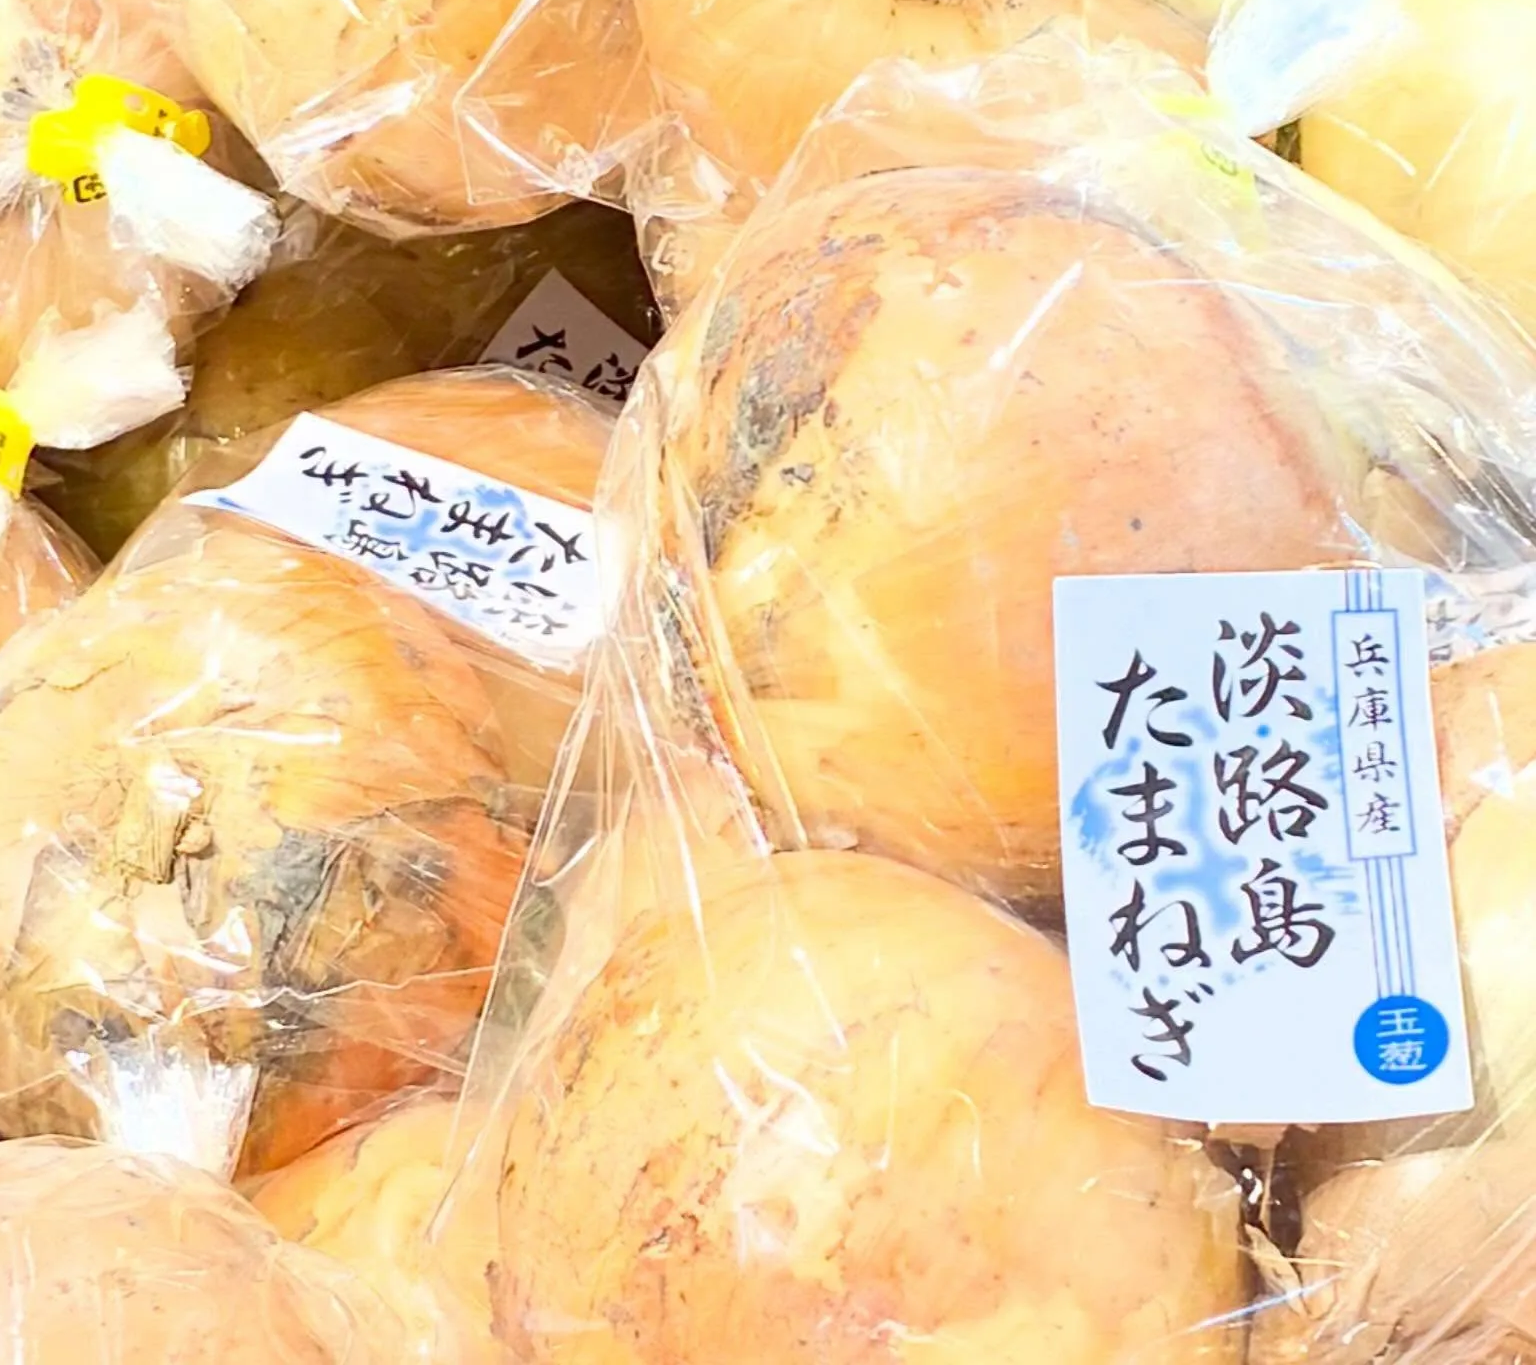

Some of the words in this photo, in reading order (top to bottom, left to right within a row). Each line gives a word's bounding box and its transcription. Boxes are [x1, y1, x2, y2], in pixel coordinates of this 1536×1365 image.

[300, 446, 588, 573] たまねぎ
[1212, 610, 1335, 970] 淡路島
[1344, 633, 1402, 835] 兵庫県産
[1095, 648, 1215, 1082] たまねぎ
[1376, 1007, 1427, 1071] 玉葱
